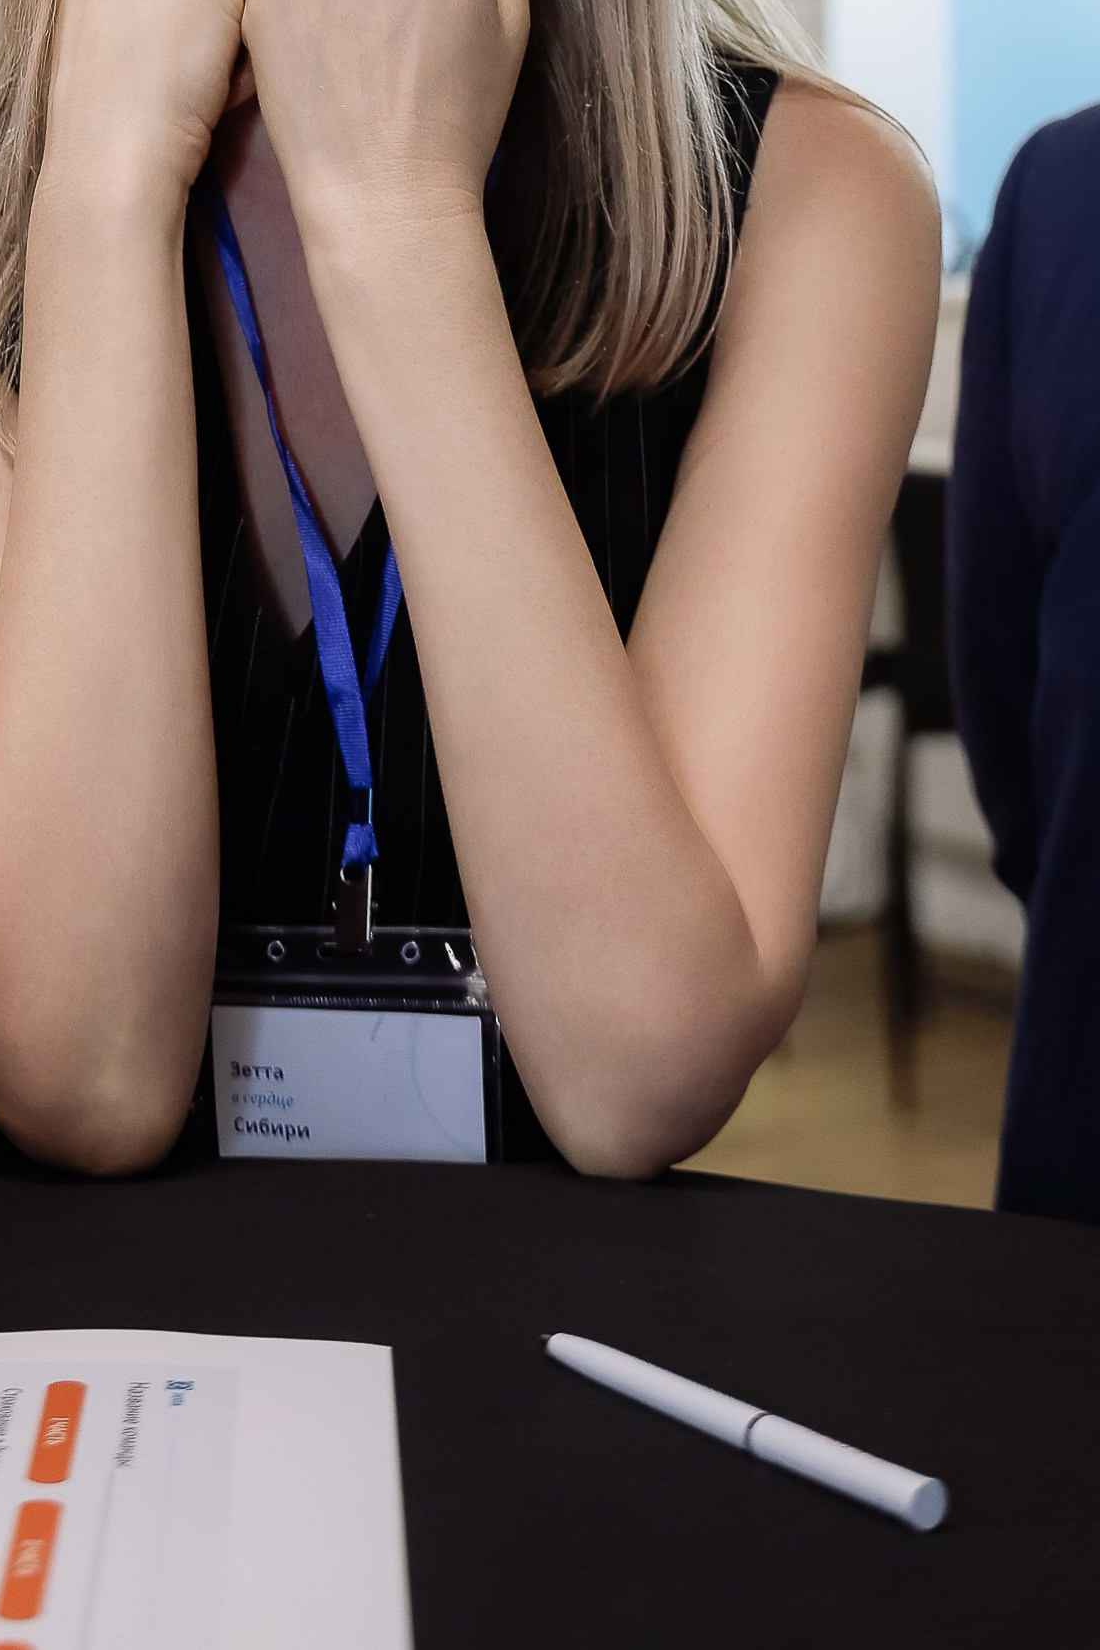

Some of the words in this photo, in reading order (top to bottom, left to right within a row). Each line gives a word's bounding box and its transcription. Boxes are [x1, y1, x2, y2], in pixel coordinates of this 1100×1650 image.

[230, 1060, 284, 1081] Зетта
[242, 1091, 294, 1110] сердце
[233, 1116, 310, 1142] Сибири
[122, 1381, 151, 1424] Название
